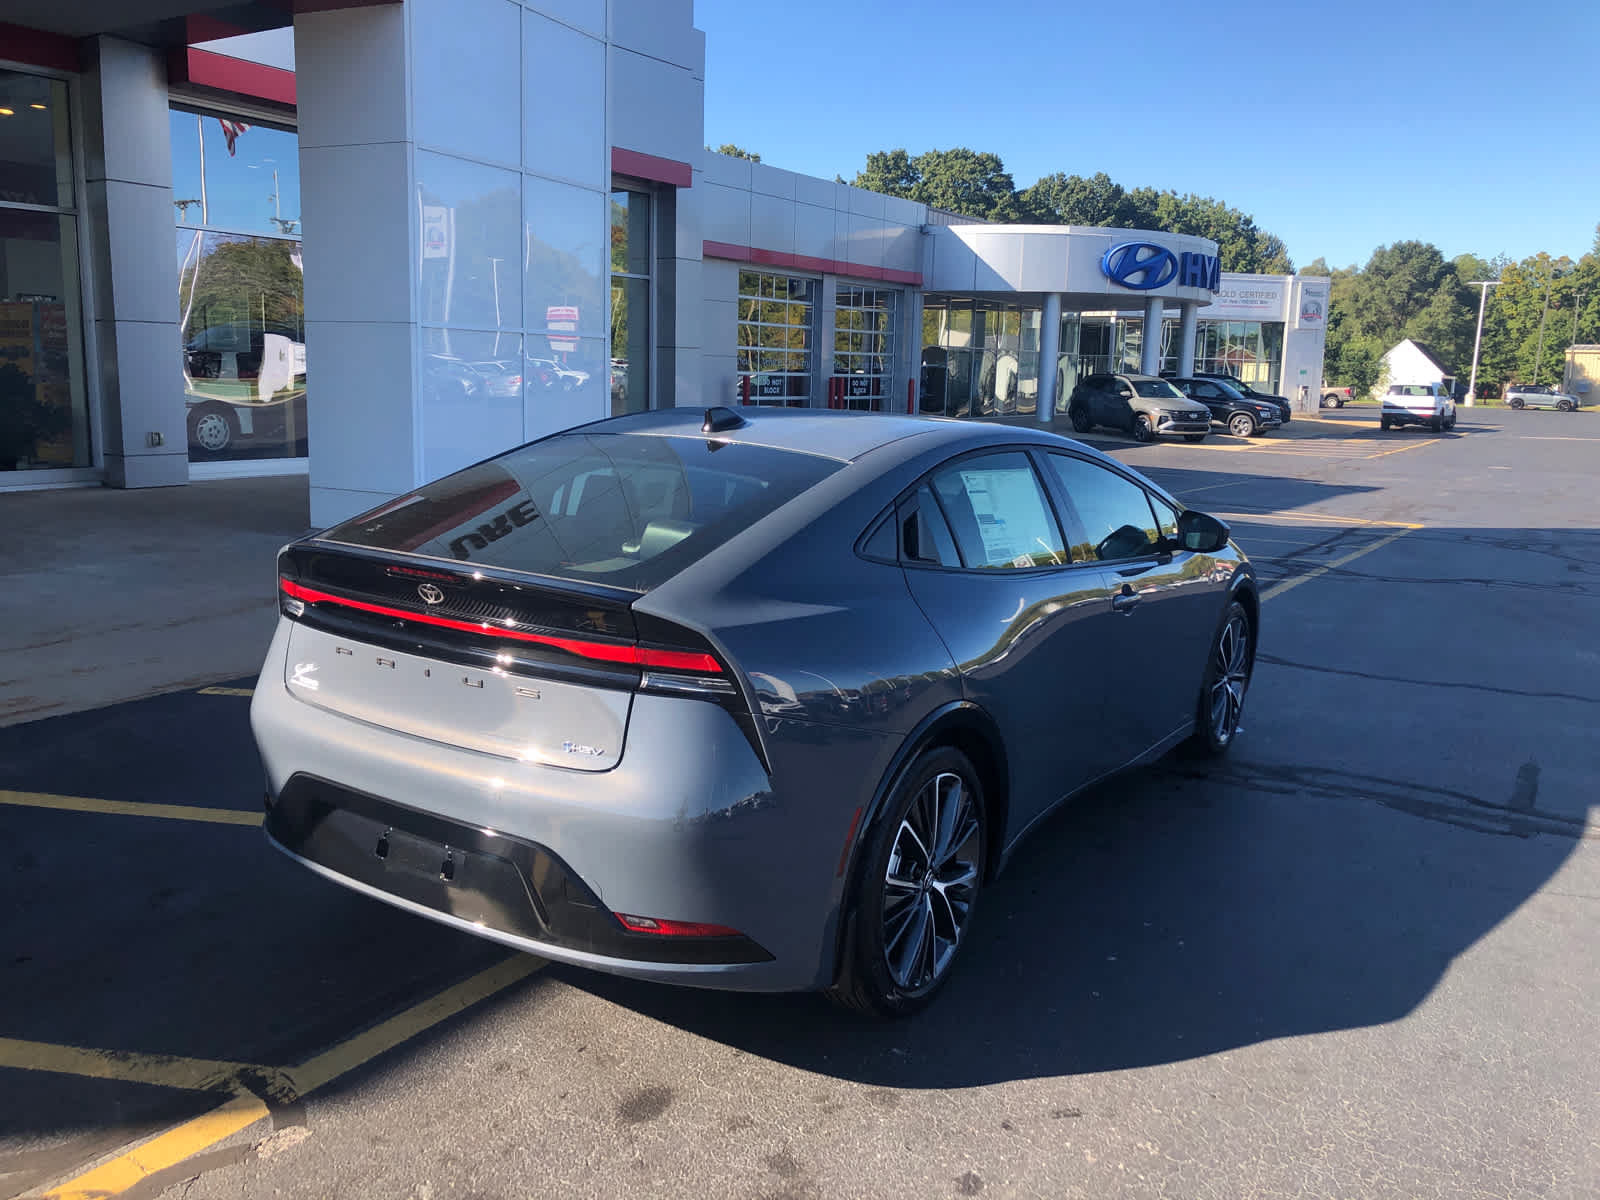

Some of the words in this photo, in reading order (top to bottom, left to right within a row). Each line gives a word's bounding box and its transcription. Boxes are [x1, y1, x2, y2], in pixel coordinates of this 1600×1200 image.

[1180, 252, 1220, 290] HY
[1239, 290, 1277, 299] CERTIFIED
[335, 646, 541, 699] PRIUS
